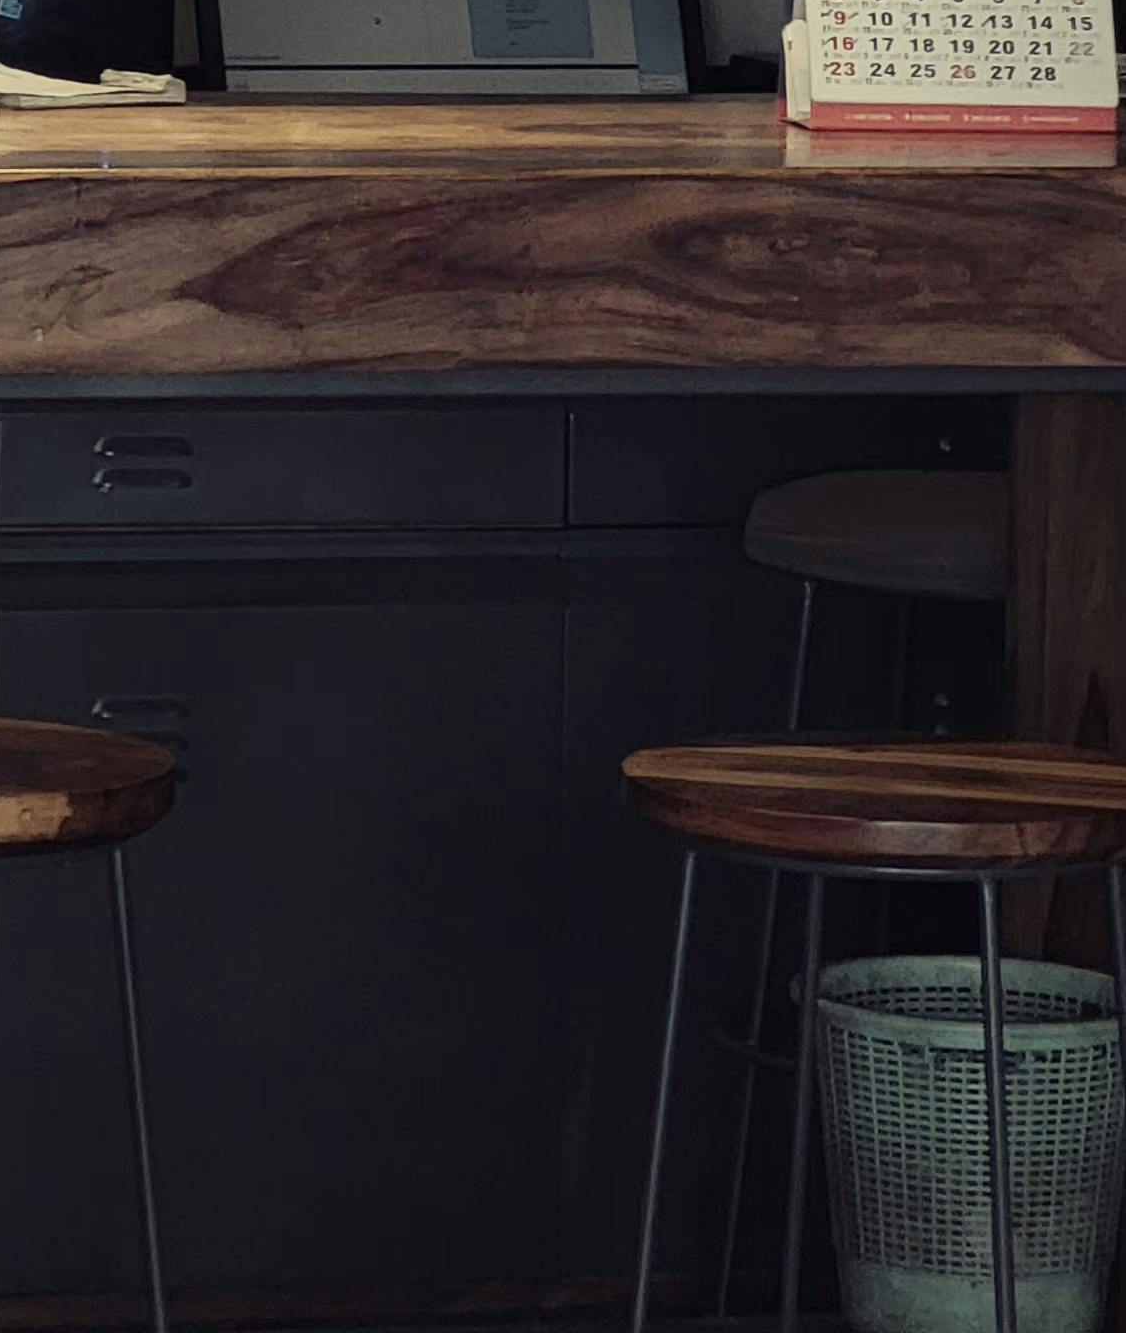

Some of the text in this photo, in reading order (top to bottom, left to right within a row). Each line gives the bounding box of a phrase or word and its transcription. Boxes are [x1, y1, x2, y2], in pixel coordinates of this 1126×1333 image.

[834, 11, 1093, 31] 9 10 11 12 13 14 15
[829, 36, 1095, 56] 16 17 18 19 20 21 22
[830, 62, 1056, 81] 23 24 25 26 27 28
